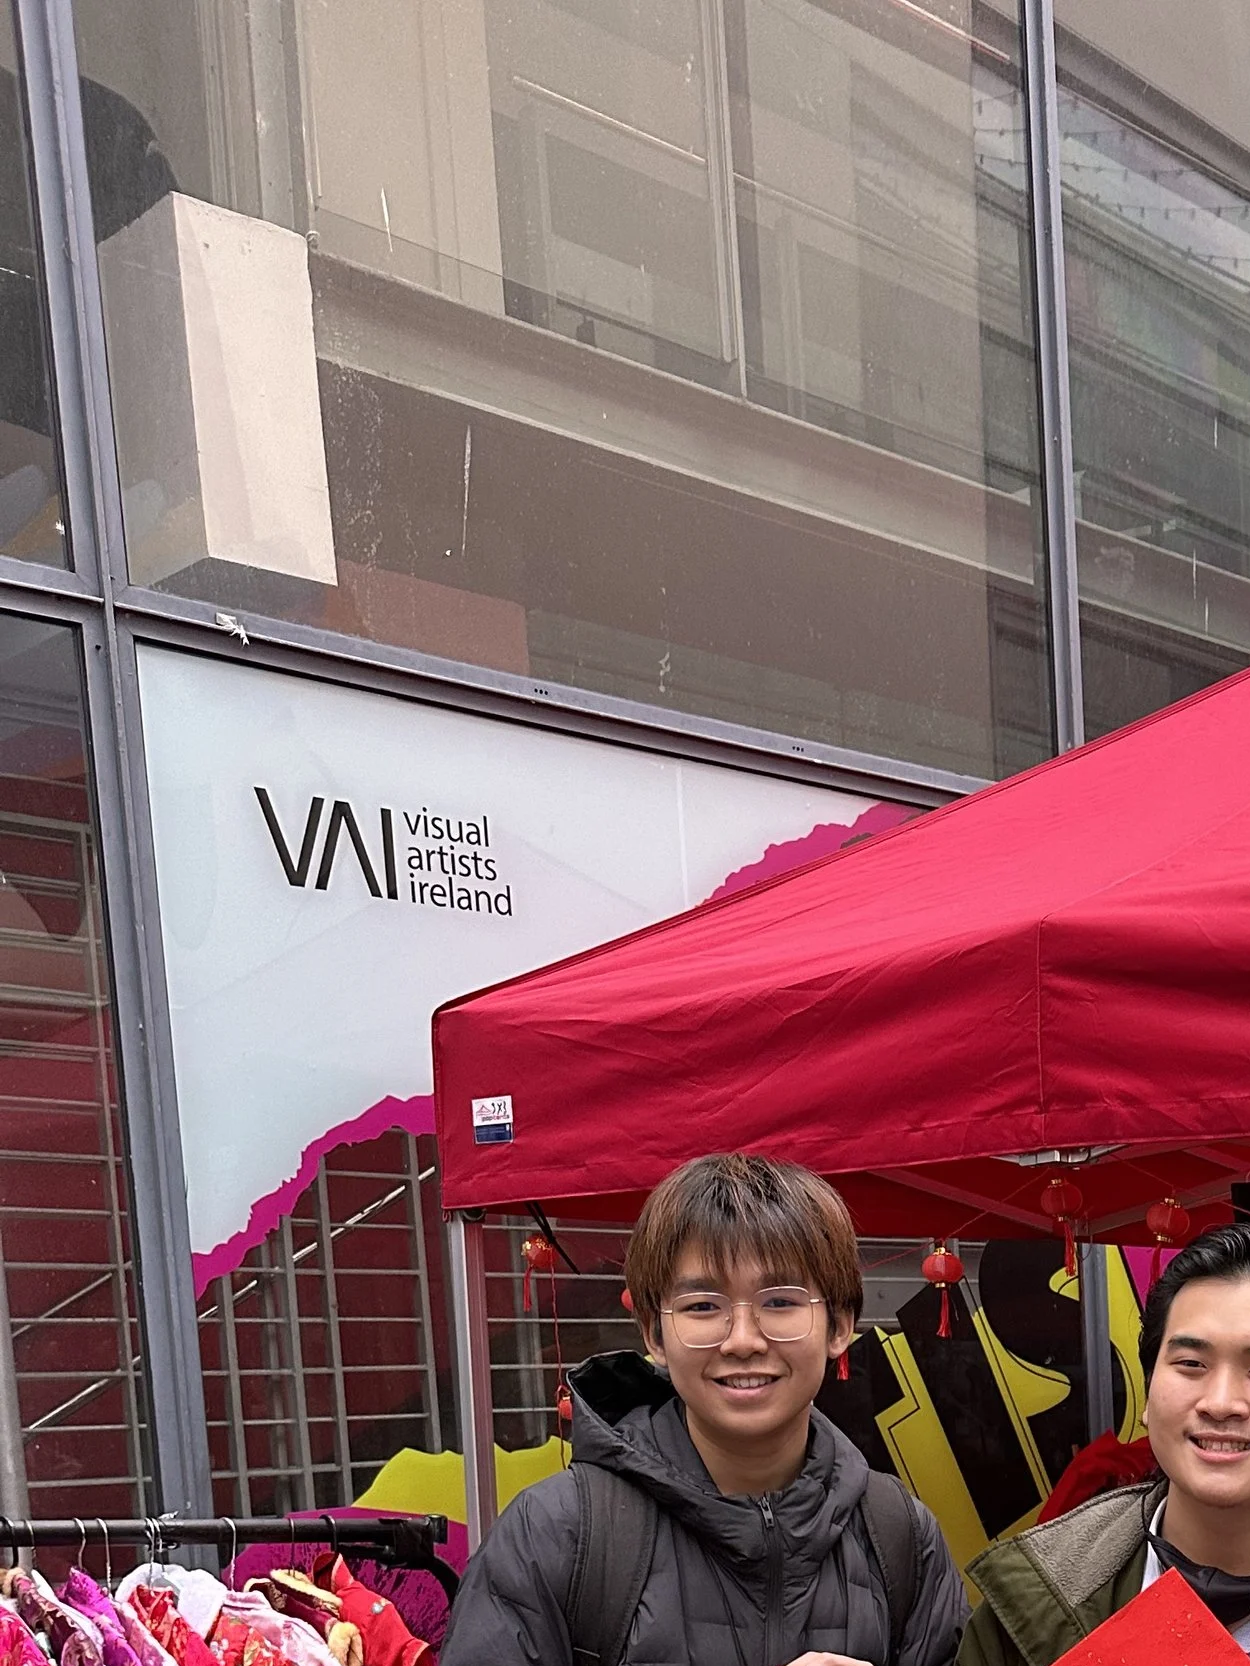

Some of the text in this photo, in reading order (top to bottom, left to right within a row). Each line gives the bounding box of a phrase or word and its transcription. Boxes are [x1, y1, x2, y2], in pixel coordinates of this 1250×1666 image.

[402, 807, 490, 847] visual
[407, 845, 498, 882] artists
[409, 873, 514, 916] ireland
